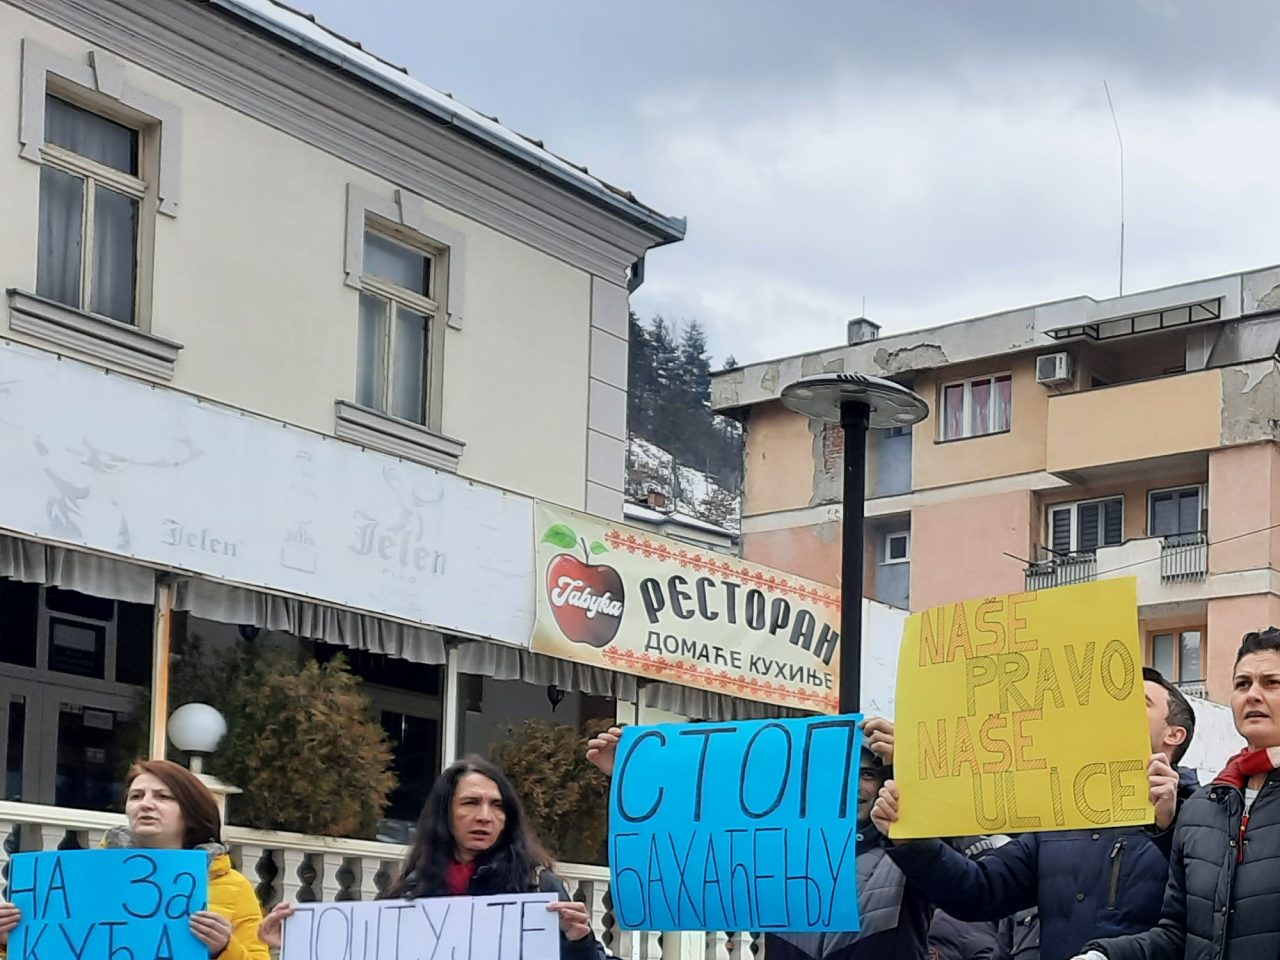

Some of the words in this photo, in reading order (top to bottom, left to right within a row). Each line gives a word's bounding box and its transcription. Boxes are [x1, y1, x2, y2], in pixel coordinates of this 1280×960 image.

[639, 574, 839, 666] РЕСТОРАН
[644, 631, 742, 669] ДОМАЋЕ
[749, 654, 832, 690] КУХИЊЕ
[965, 640, 1135, 717] PRAVO
[616, 720, 856, 823] СТОП
[9, 856, 71, 919] НА
